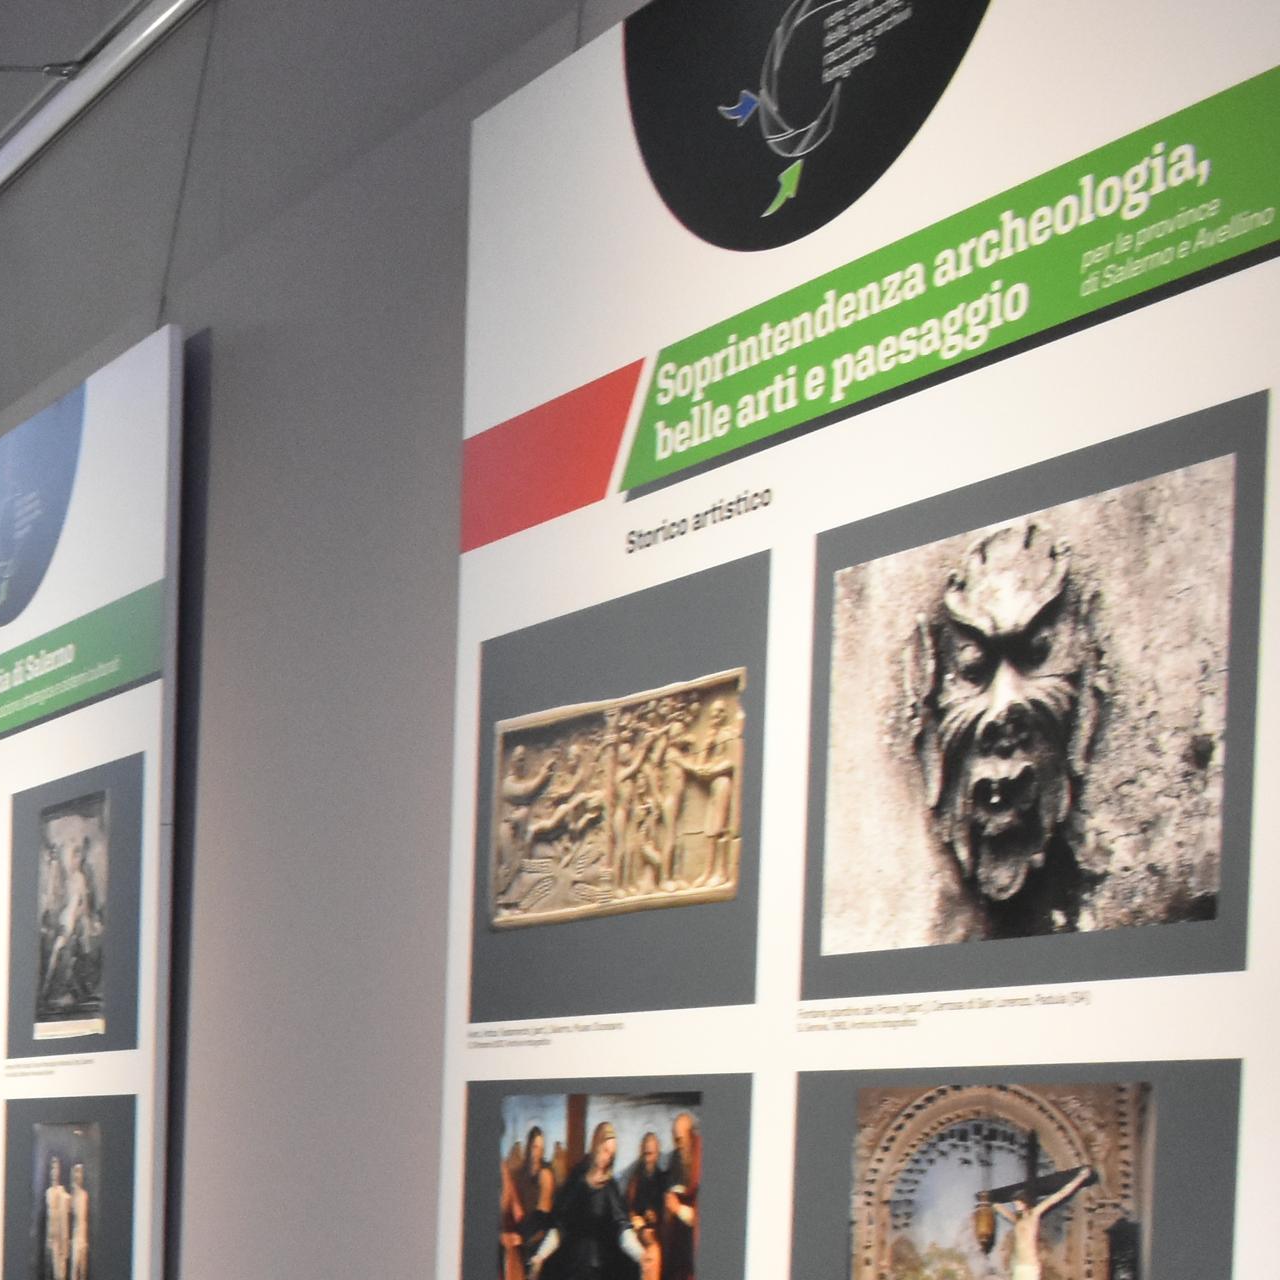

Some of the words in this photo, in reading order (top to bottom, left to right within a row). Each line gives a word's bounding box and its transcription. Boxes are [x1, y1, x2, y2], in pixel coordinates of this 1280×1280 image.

[656, 262, 927, 406] Soprintendenza
[933, 141, 1211, 288] archeologia,
[1080, 242, 1113, 274] per
[1115, 232, 1134, 255] le
[1135, 199, 1221, 251] province
[1080, 271, 1101, 297] di
[1101, 246, 1174, 288] Salerno
[1176, 240, 1191, 259] e
[1191, 206, 1275, 254] Avellino
[655, 401, 731, 461] belle
[736, 365, 798, 428] arti
[804, 365, 826, 401] e
[830, 279, 1029, 403] paesaggio
[626, 518, 688, 554] Storico
[692, 488, 773, 531] artistico
[26, 643, 75, 682] Salerno
